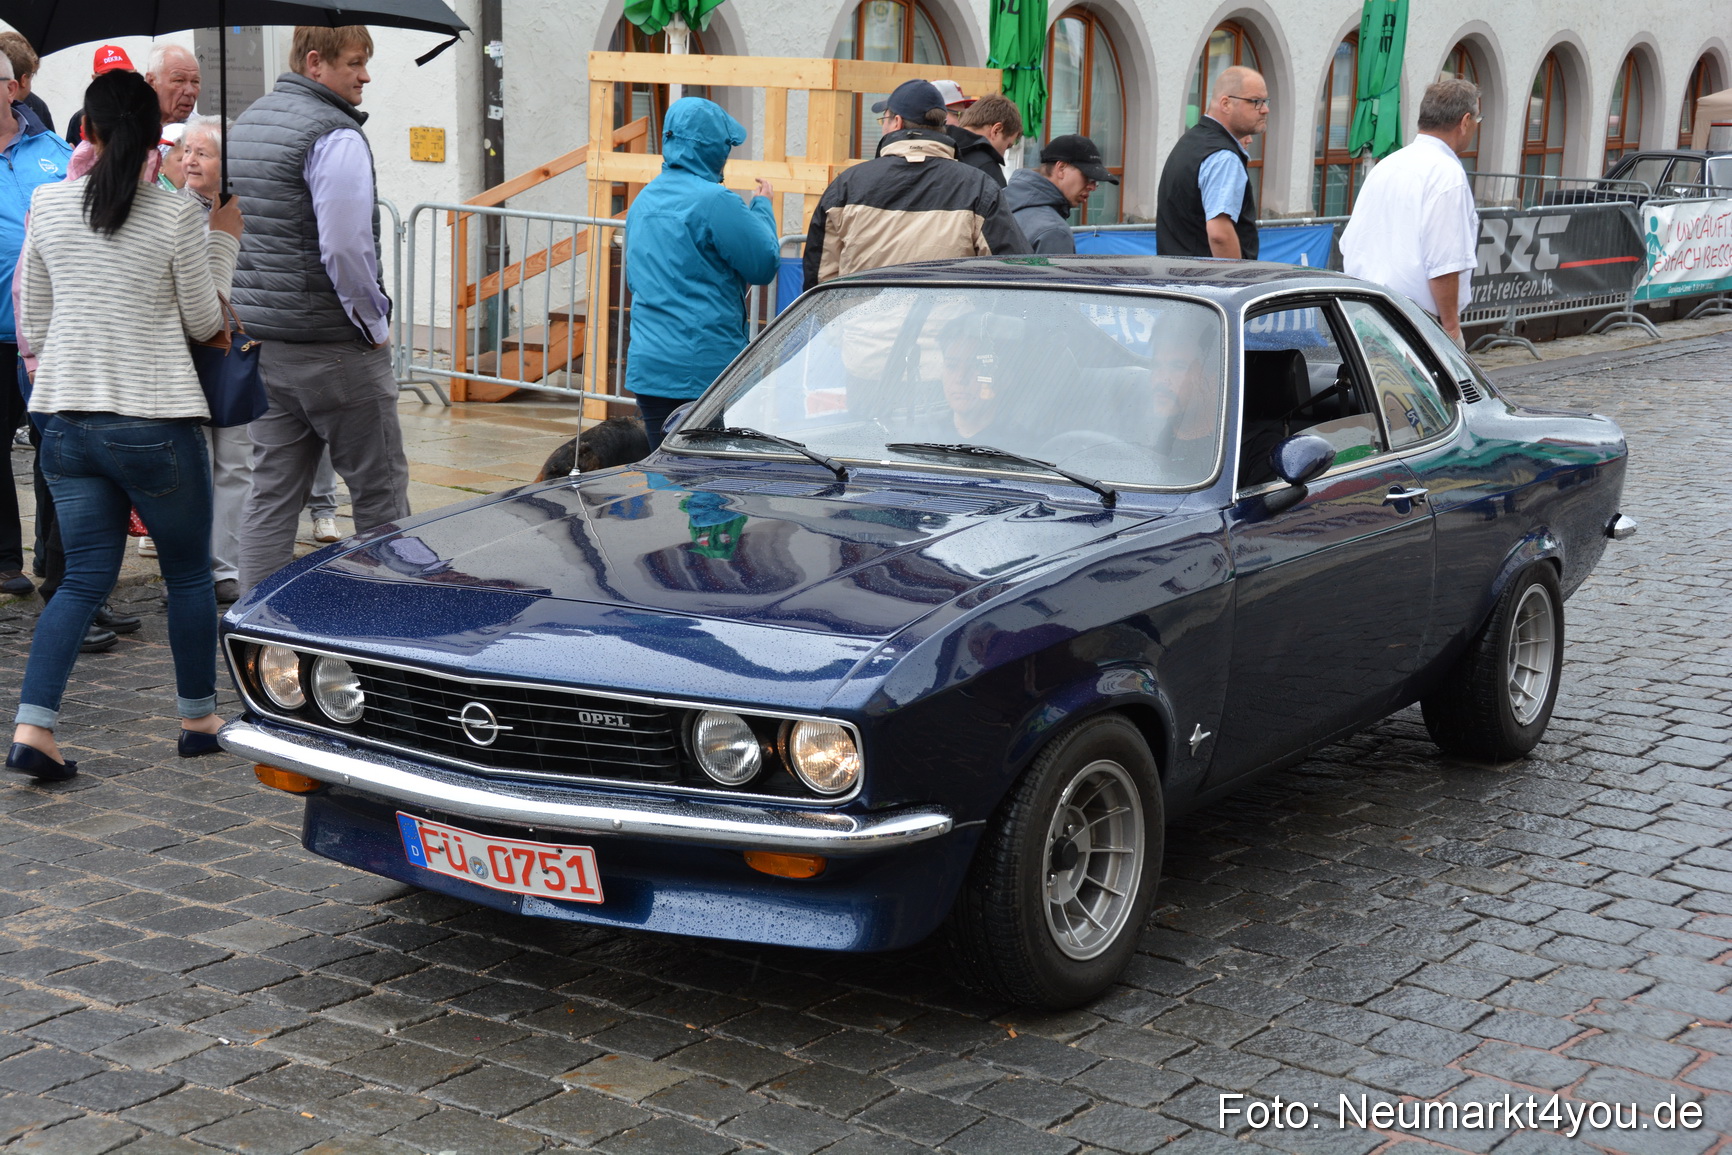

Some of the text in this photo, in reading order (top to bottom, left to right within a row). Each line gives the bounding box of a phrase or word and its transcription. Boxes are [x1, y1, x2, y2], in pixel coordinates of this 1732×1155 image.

[103, 56, 124, 64] DEKRA
[1473, 215, 1571, 277] RZT
[578, 711, 630, 728] OPEL
[411, 844, 420, 857] D
[418, 826, 595, 895] FÜ 0751
